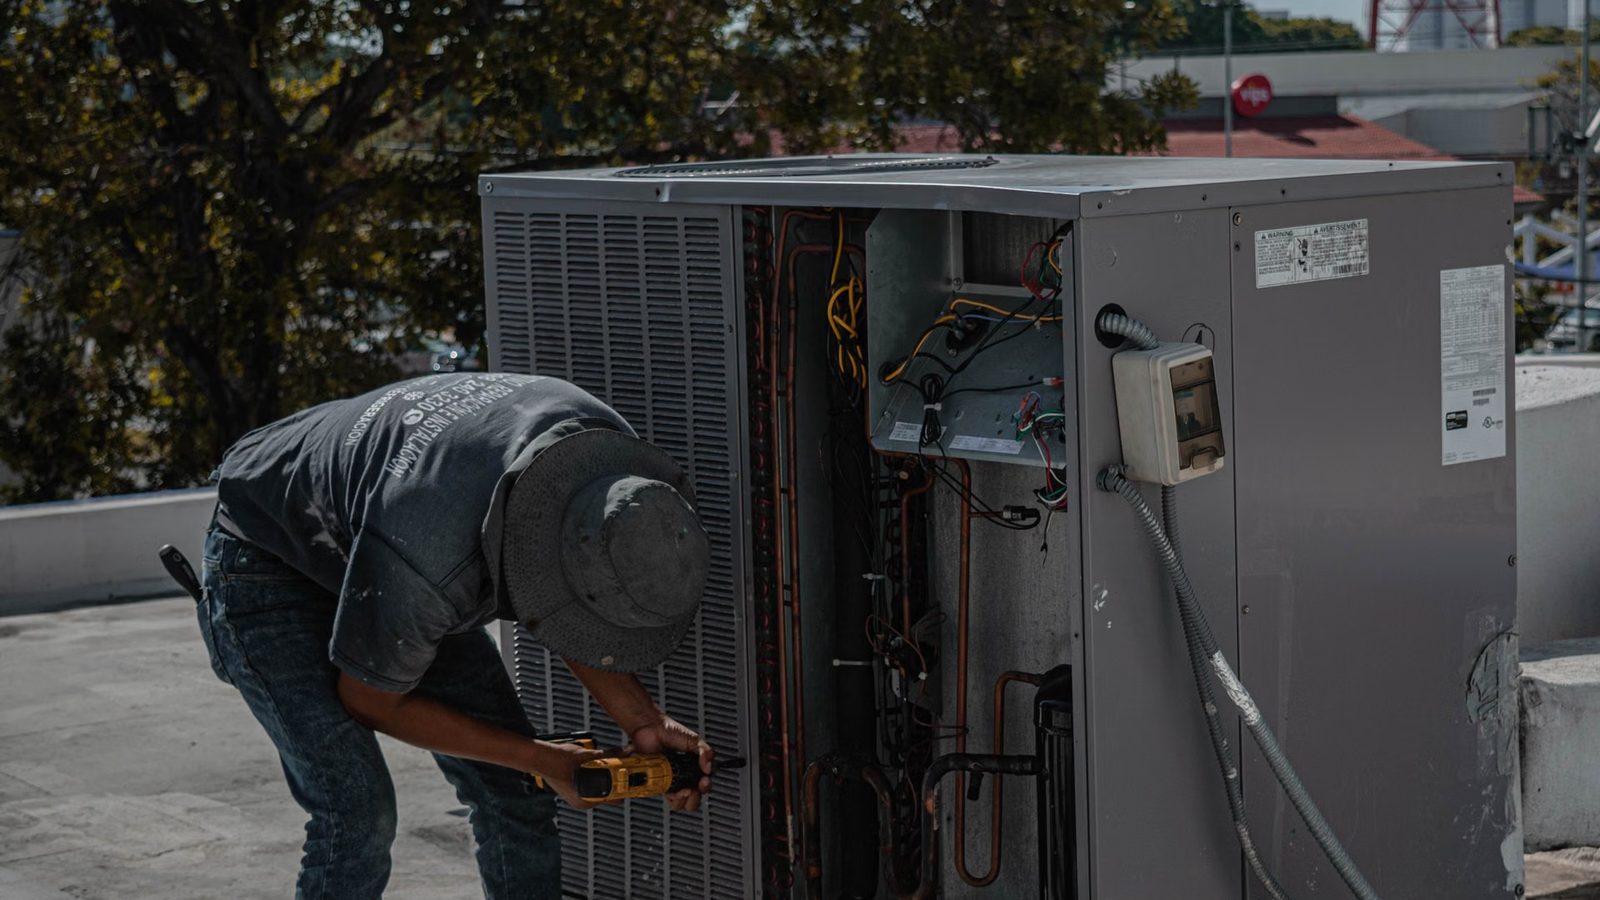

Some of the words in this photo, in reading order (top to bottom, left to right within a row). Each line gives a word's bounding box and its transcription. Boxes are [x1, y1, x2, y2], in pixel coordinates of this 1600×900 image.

[1268, 231, 1293, 239] WARNING
[453, 380, 485, 394] 240
[417, 391, 458, 411] 3230
[385, 413, 452, 478] INSTALACIÓN
